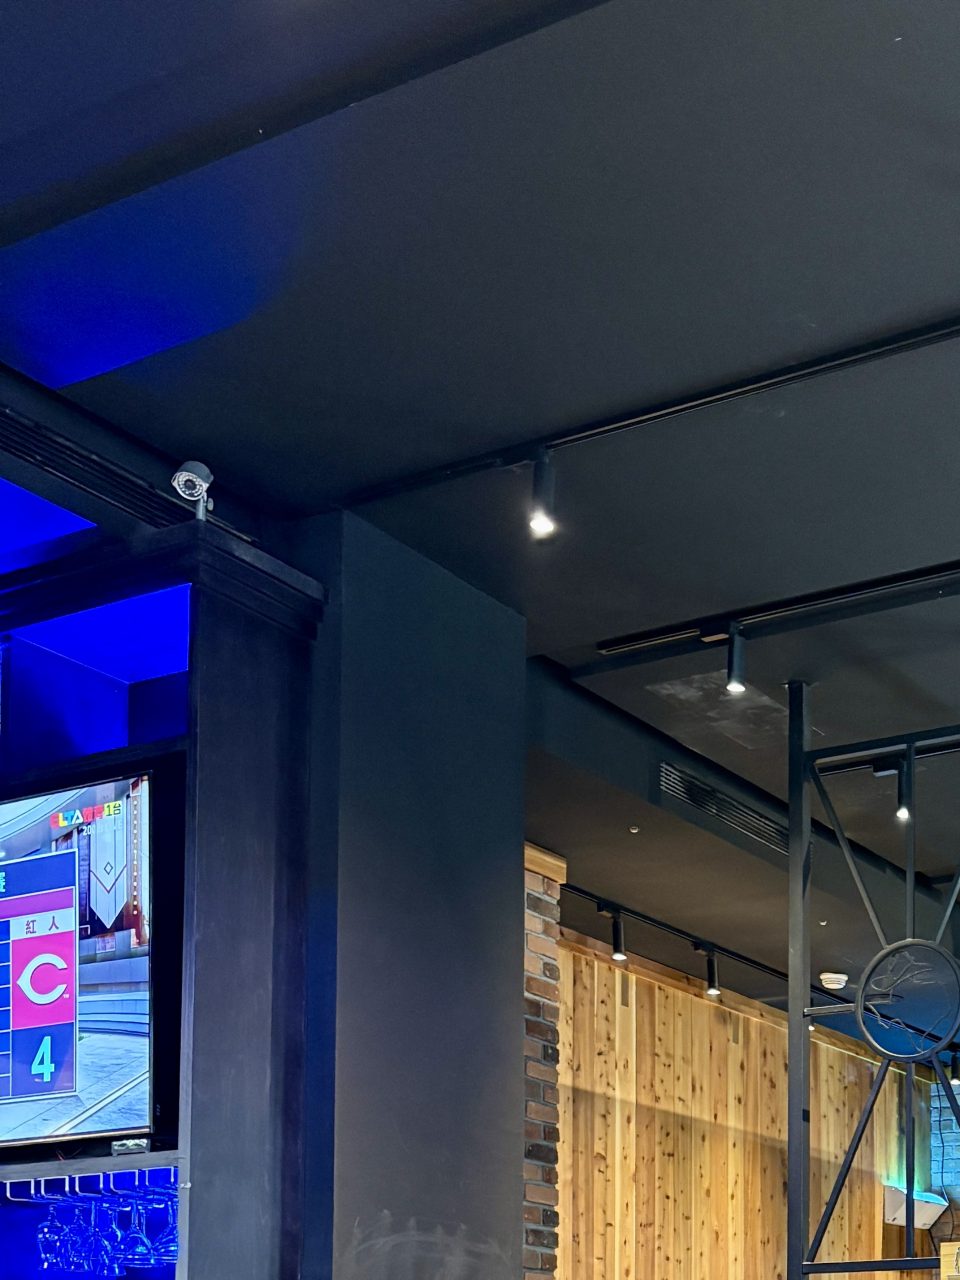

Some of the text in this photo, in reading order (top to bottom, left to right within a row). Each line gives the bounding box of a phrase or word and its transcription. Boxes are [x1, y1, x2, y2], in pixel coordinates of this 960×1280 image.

[25, 915, 60, 935] 紅人
[16, 953, 68, 1005] C
[31, 1036, 55, 1082] 4
